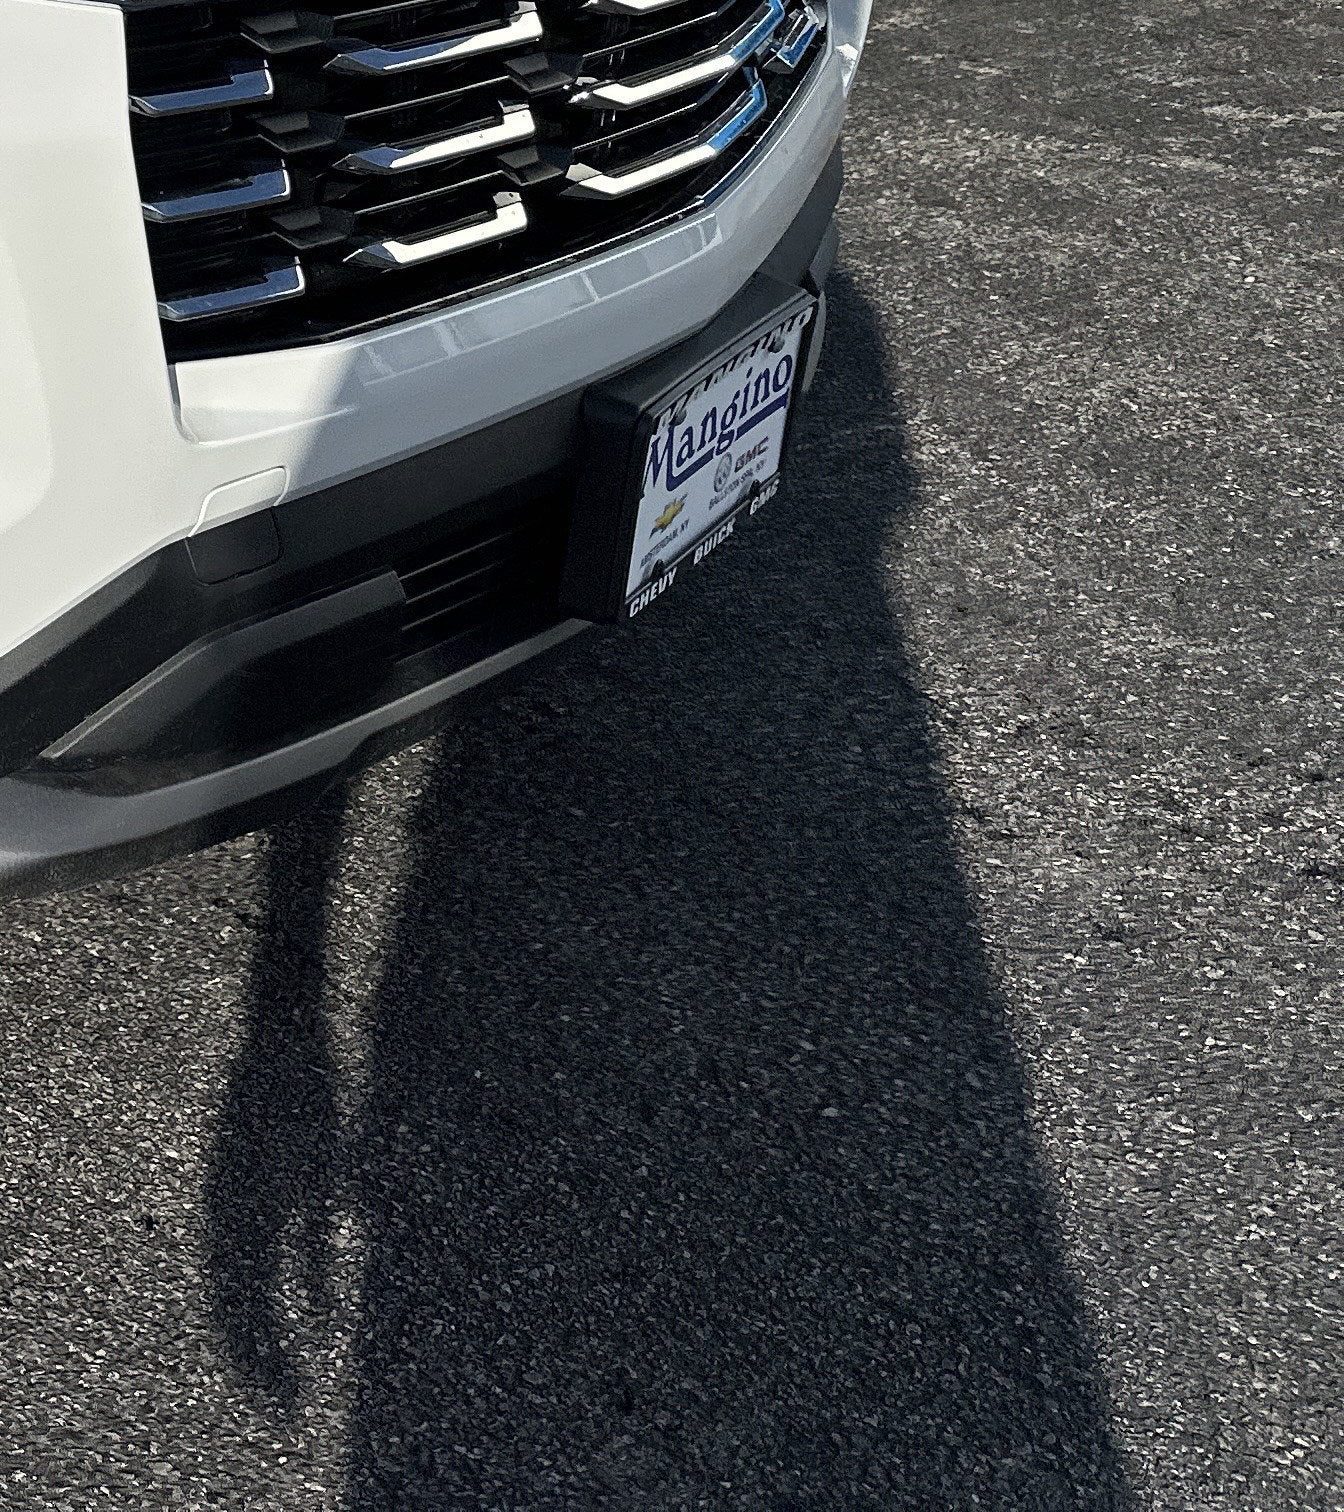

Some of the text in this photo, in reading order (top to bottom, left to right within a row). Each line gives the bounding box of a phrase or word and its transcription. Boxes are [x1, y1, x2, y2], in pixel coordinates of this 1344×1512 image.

[644, 354, 793, 492] Mangino
[630, 566, 677, 617] CHEVY
[693, 517, 736, 565] BUICK
